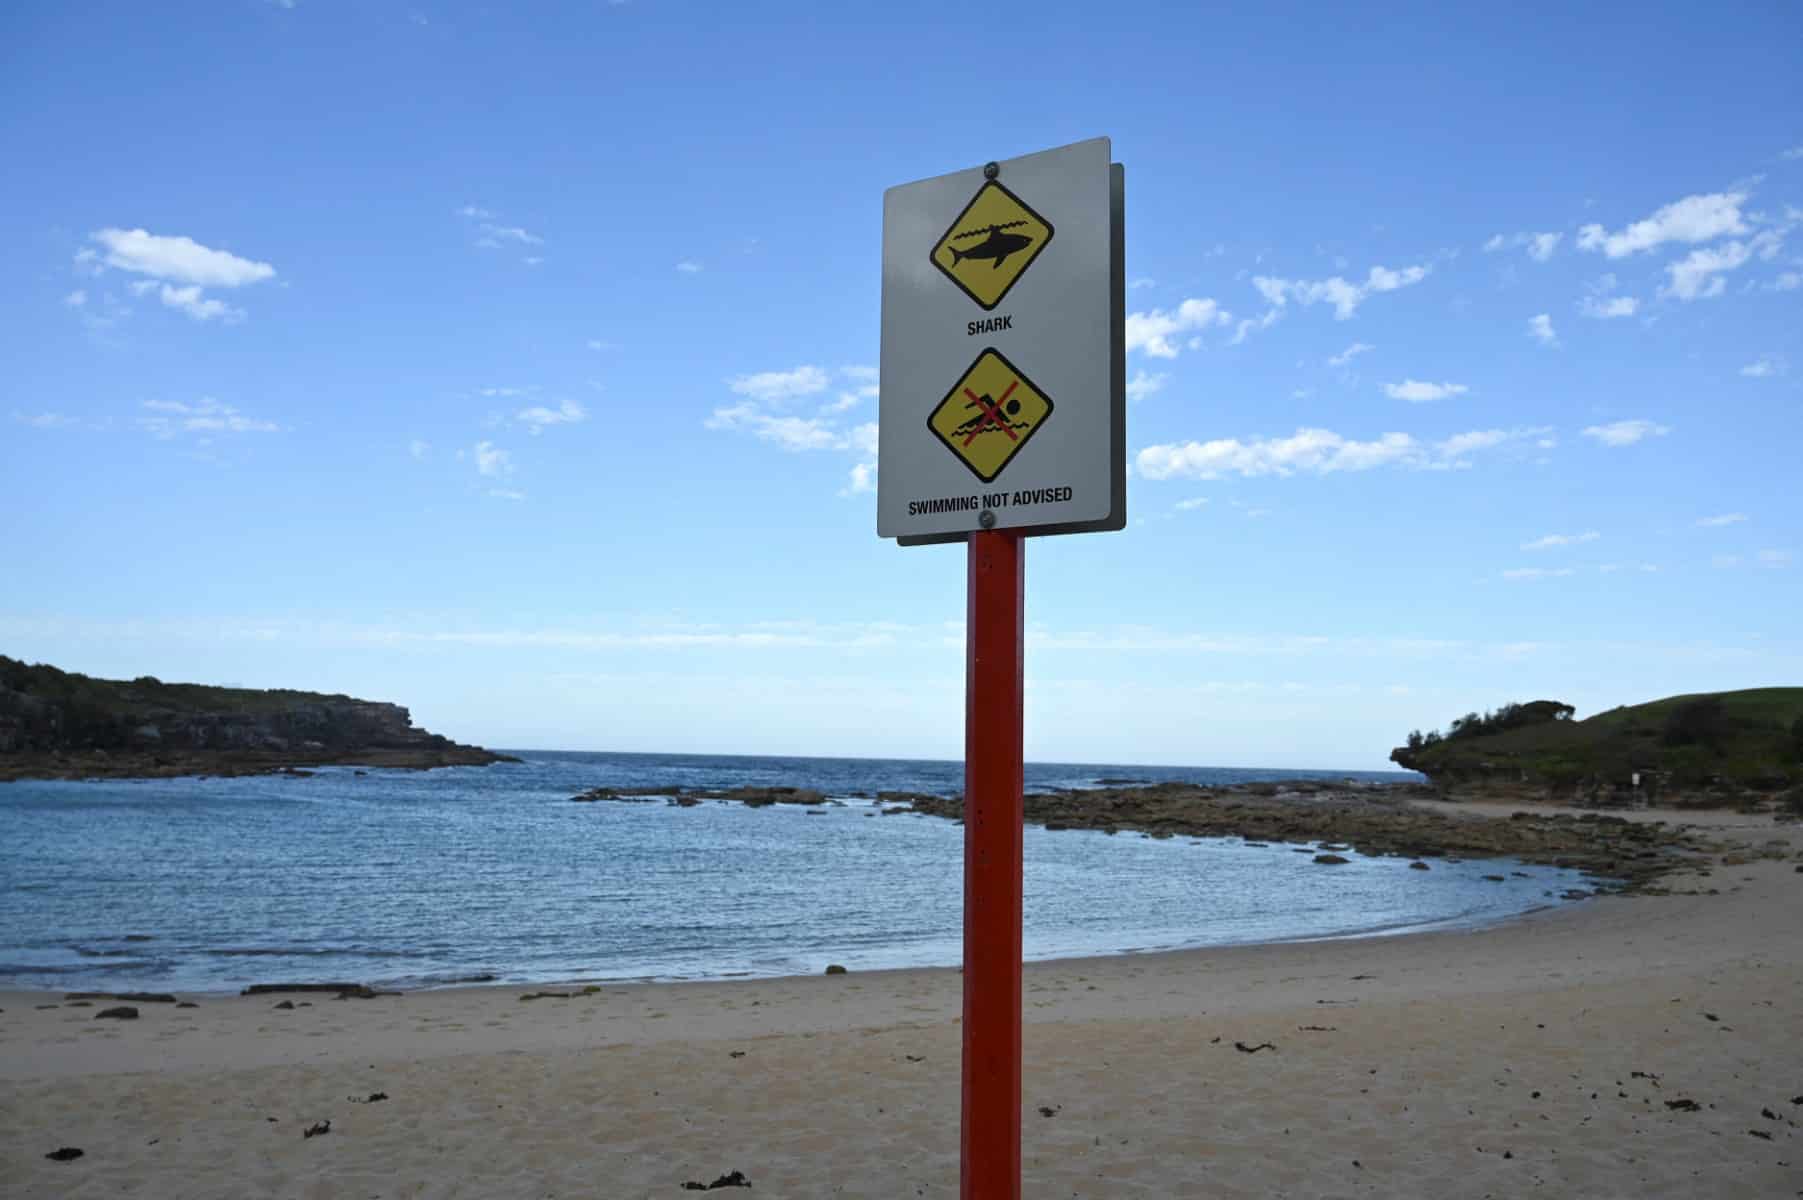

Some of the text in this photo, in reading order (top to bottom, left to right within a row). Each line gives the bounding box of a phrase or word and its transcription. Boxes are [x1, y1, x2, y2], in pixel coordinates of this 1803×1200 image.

[968, 315, 1012, 336] SHARK
[909, 486, 1073, 516] SWIMMING NOT ADVISED
